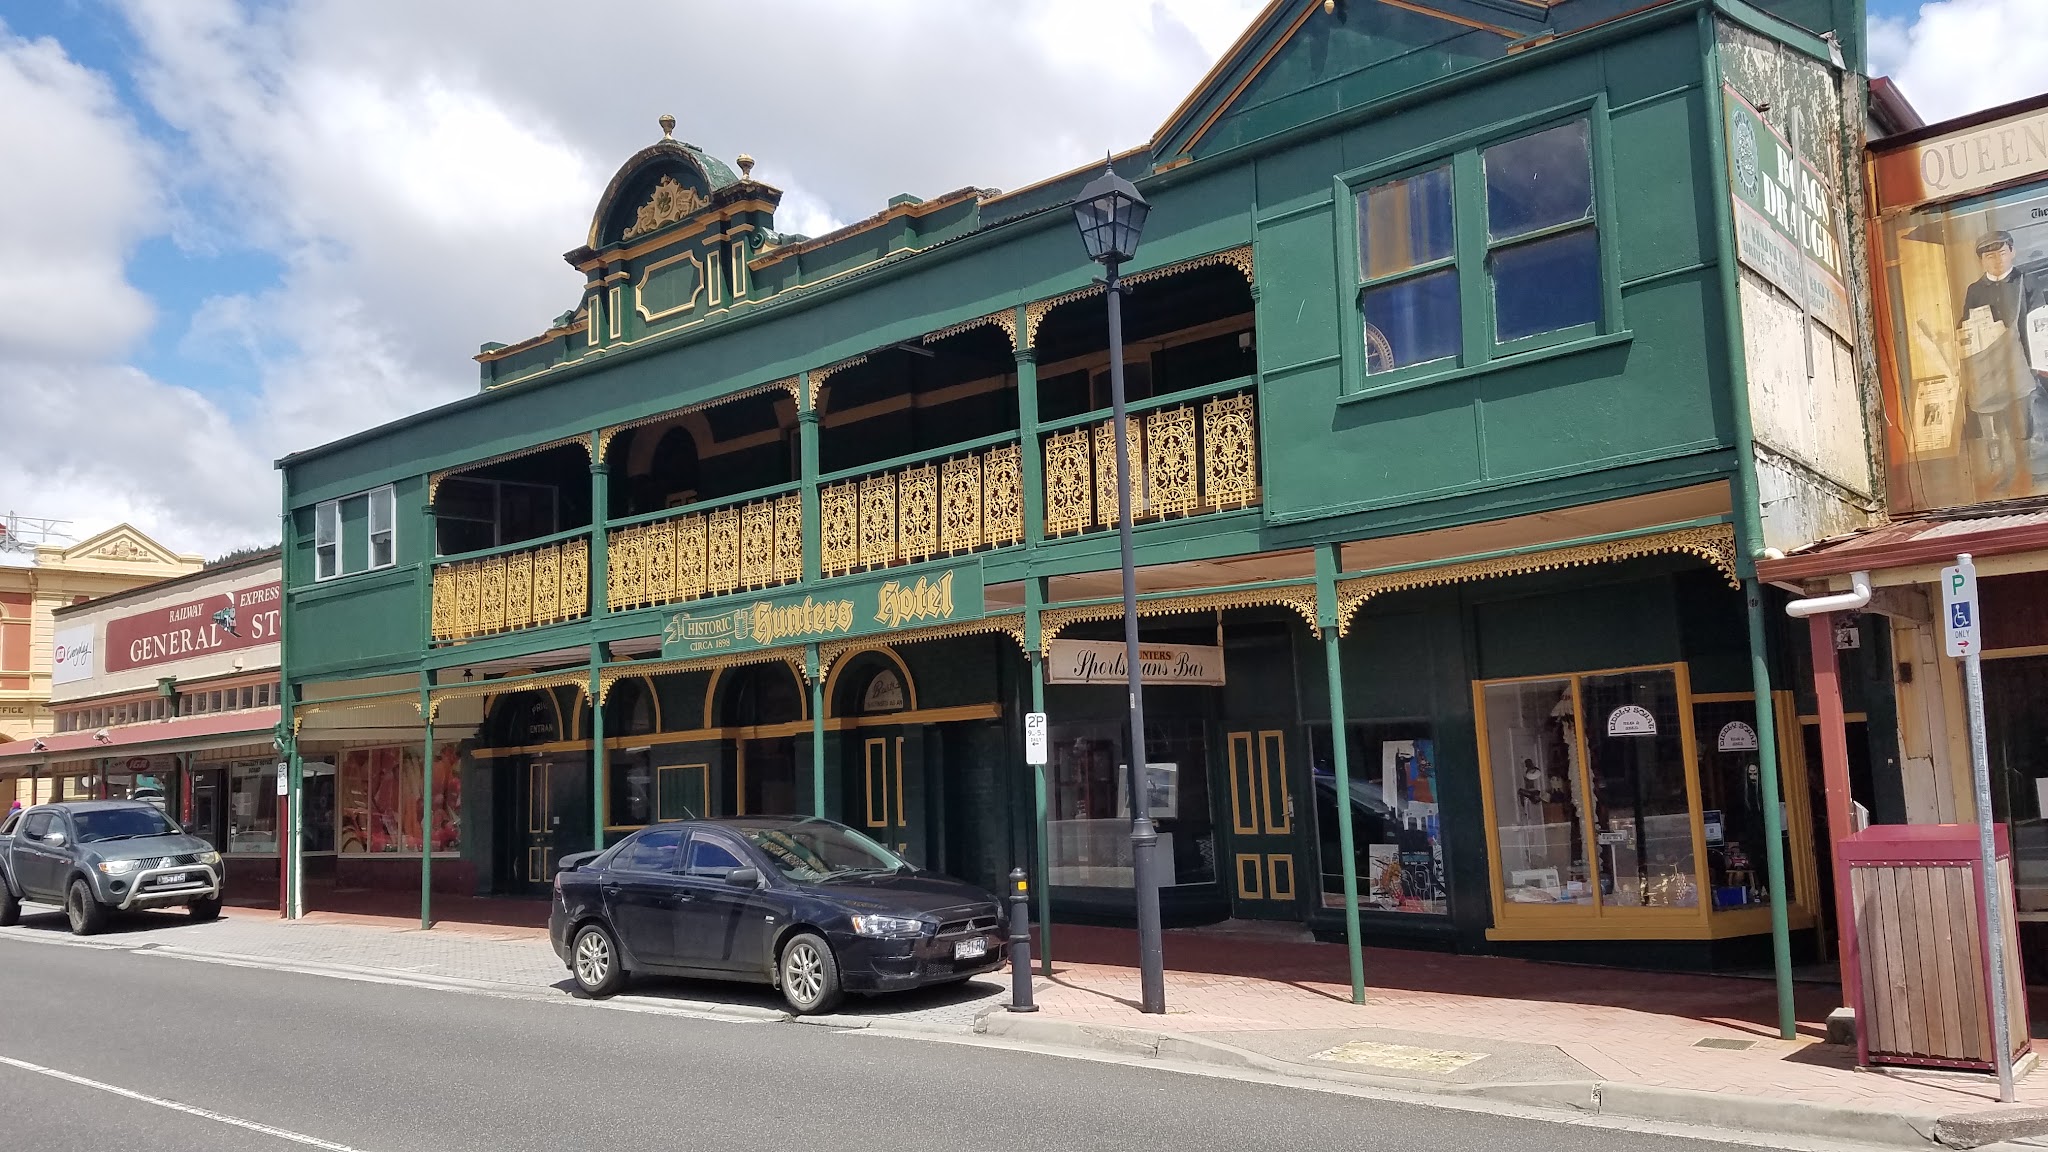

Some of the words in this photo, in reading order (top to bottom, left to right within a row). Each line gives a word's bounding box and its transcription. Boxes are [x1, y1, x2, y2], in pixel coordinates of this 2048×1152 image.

[1761, 170, 1843, 278] DRAUGHT
[1952, 574, 1966, 596] P
[169, 603, 205, 623] RAILWAY
[239, 585, 280, 608] EXPRESS
[750, 594, 855, 645] Hunters
[873, 569, 954, 628] Hotel
[130, 622, 223, 663] GENERAL
[251, 609, 282, 640] ST
[687, 616, 732, 637] HISTORIC
[1954, 630, 1971, 639] ONLY
[689, 640, 714, 651] CIRCA
[1073, 649, 1168, 683] Sportsans
[1173, 651, 1204, 679] Bar
[0, 706, 24, 714] FICE
[1610, 706, 1631, 731] DIDDLY
[1028, 715, 1044, 728] 2P
[129, 759, 149, 769] IGA
